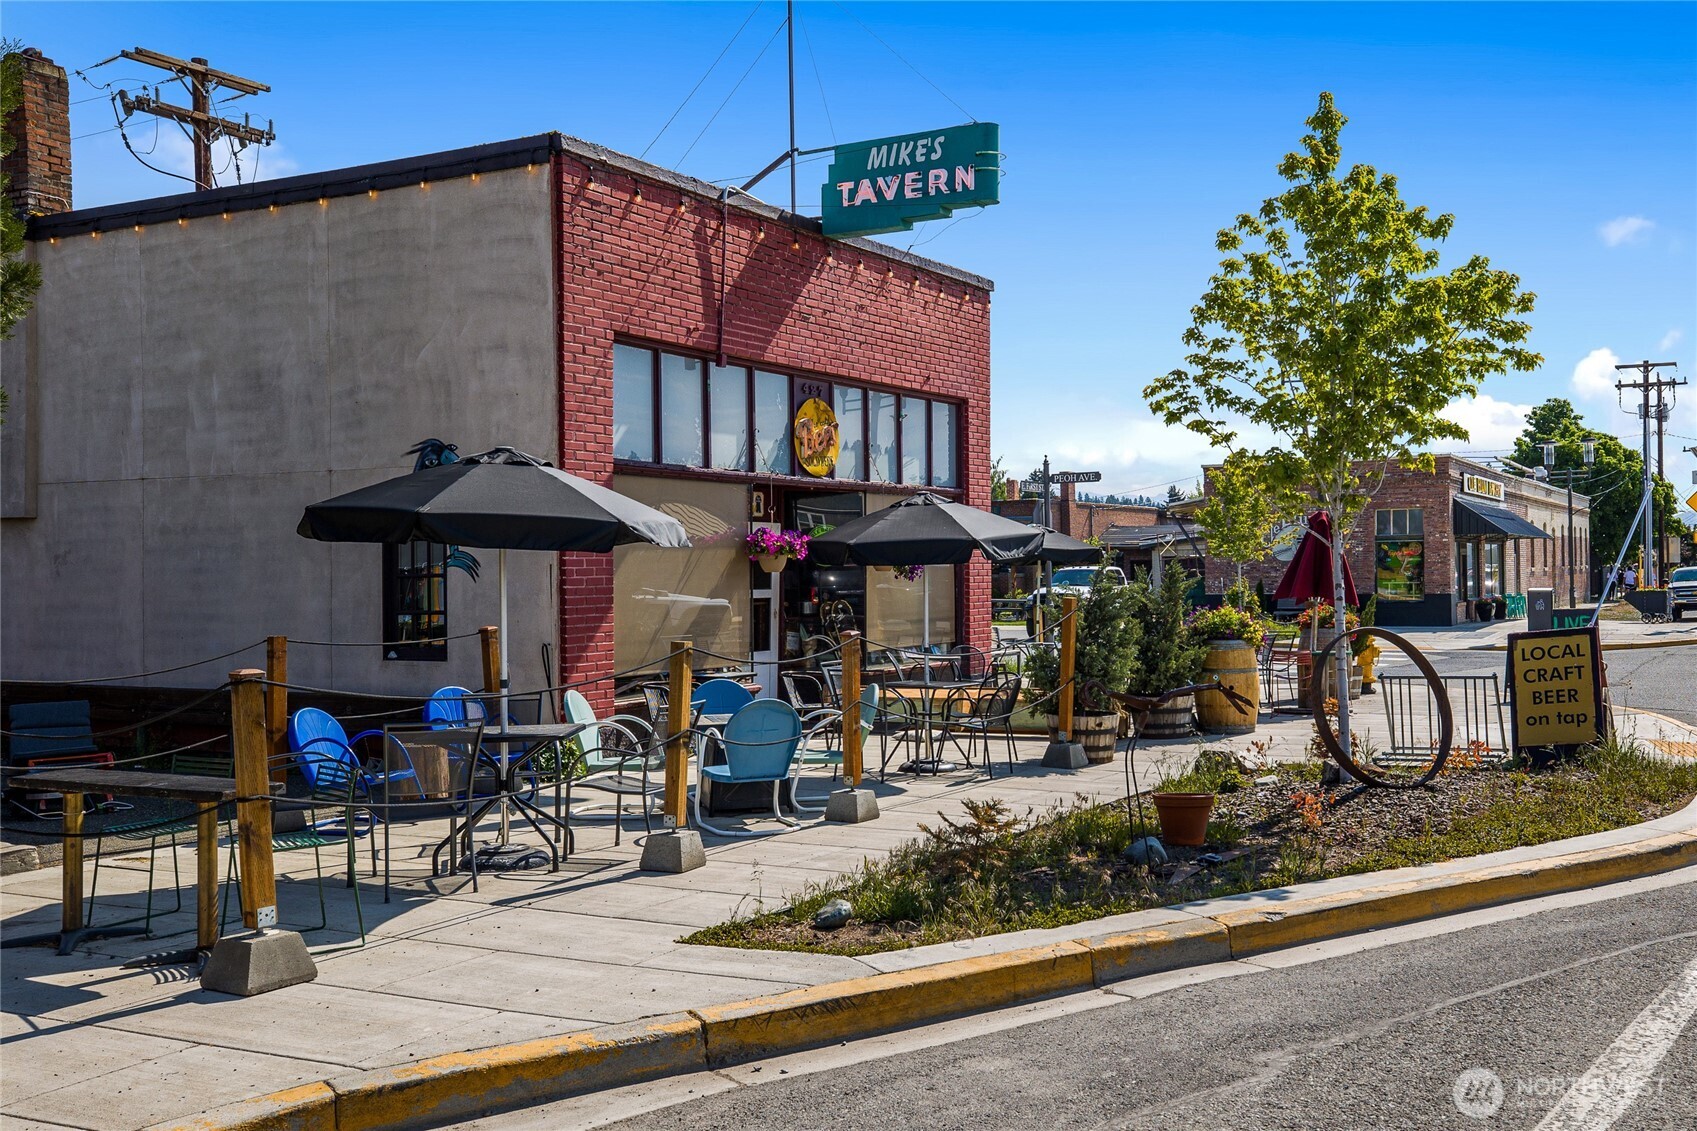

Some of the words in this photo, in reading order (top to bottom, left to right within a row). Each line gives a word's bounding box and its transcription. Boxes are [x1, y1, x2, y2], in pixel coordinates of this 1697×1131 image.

[867, 135, 945, 171] MIKE'S
[836, 163, 975, 207] TAVERN
[1054, 474, 1077, 483] PEOH
[1078, 473, 1098, 482] AVE.
[1553, 615, 1591, 630] LIVE
[1521, 643, 1586, 662] LOCAL
[1523, 665, 1585, 683] CRAFT
[1532, 688, 1579, 705] BEER
[1526, 714, 1550, 727] on
[1556, 711, 1588, 728] tap
